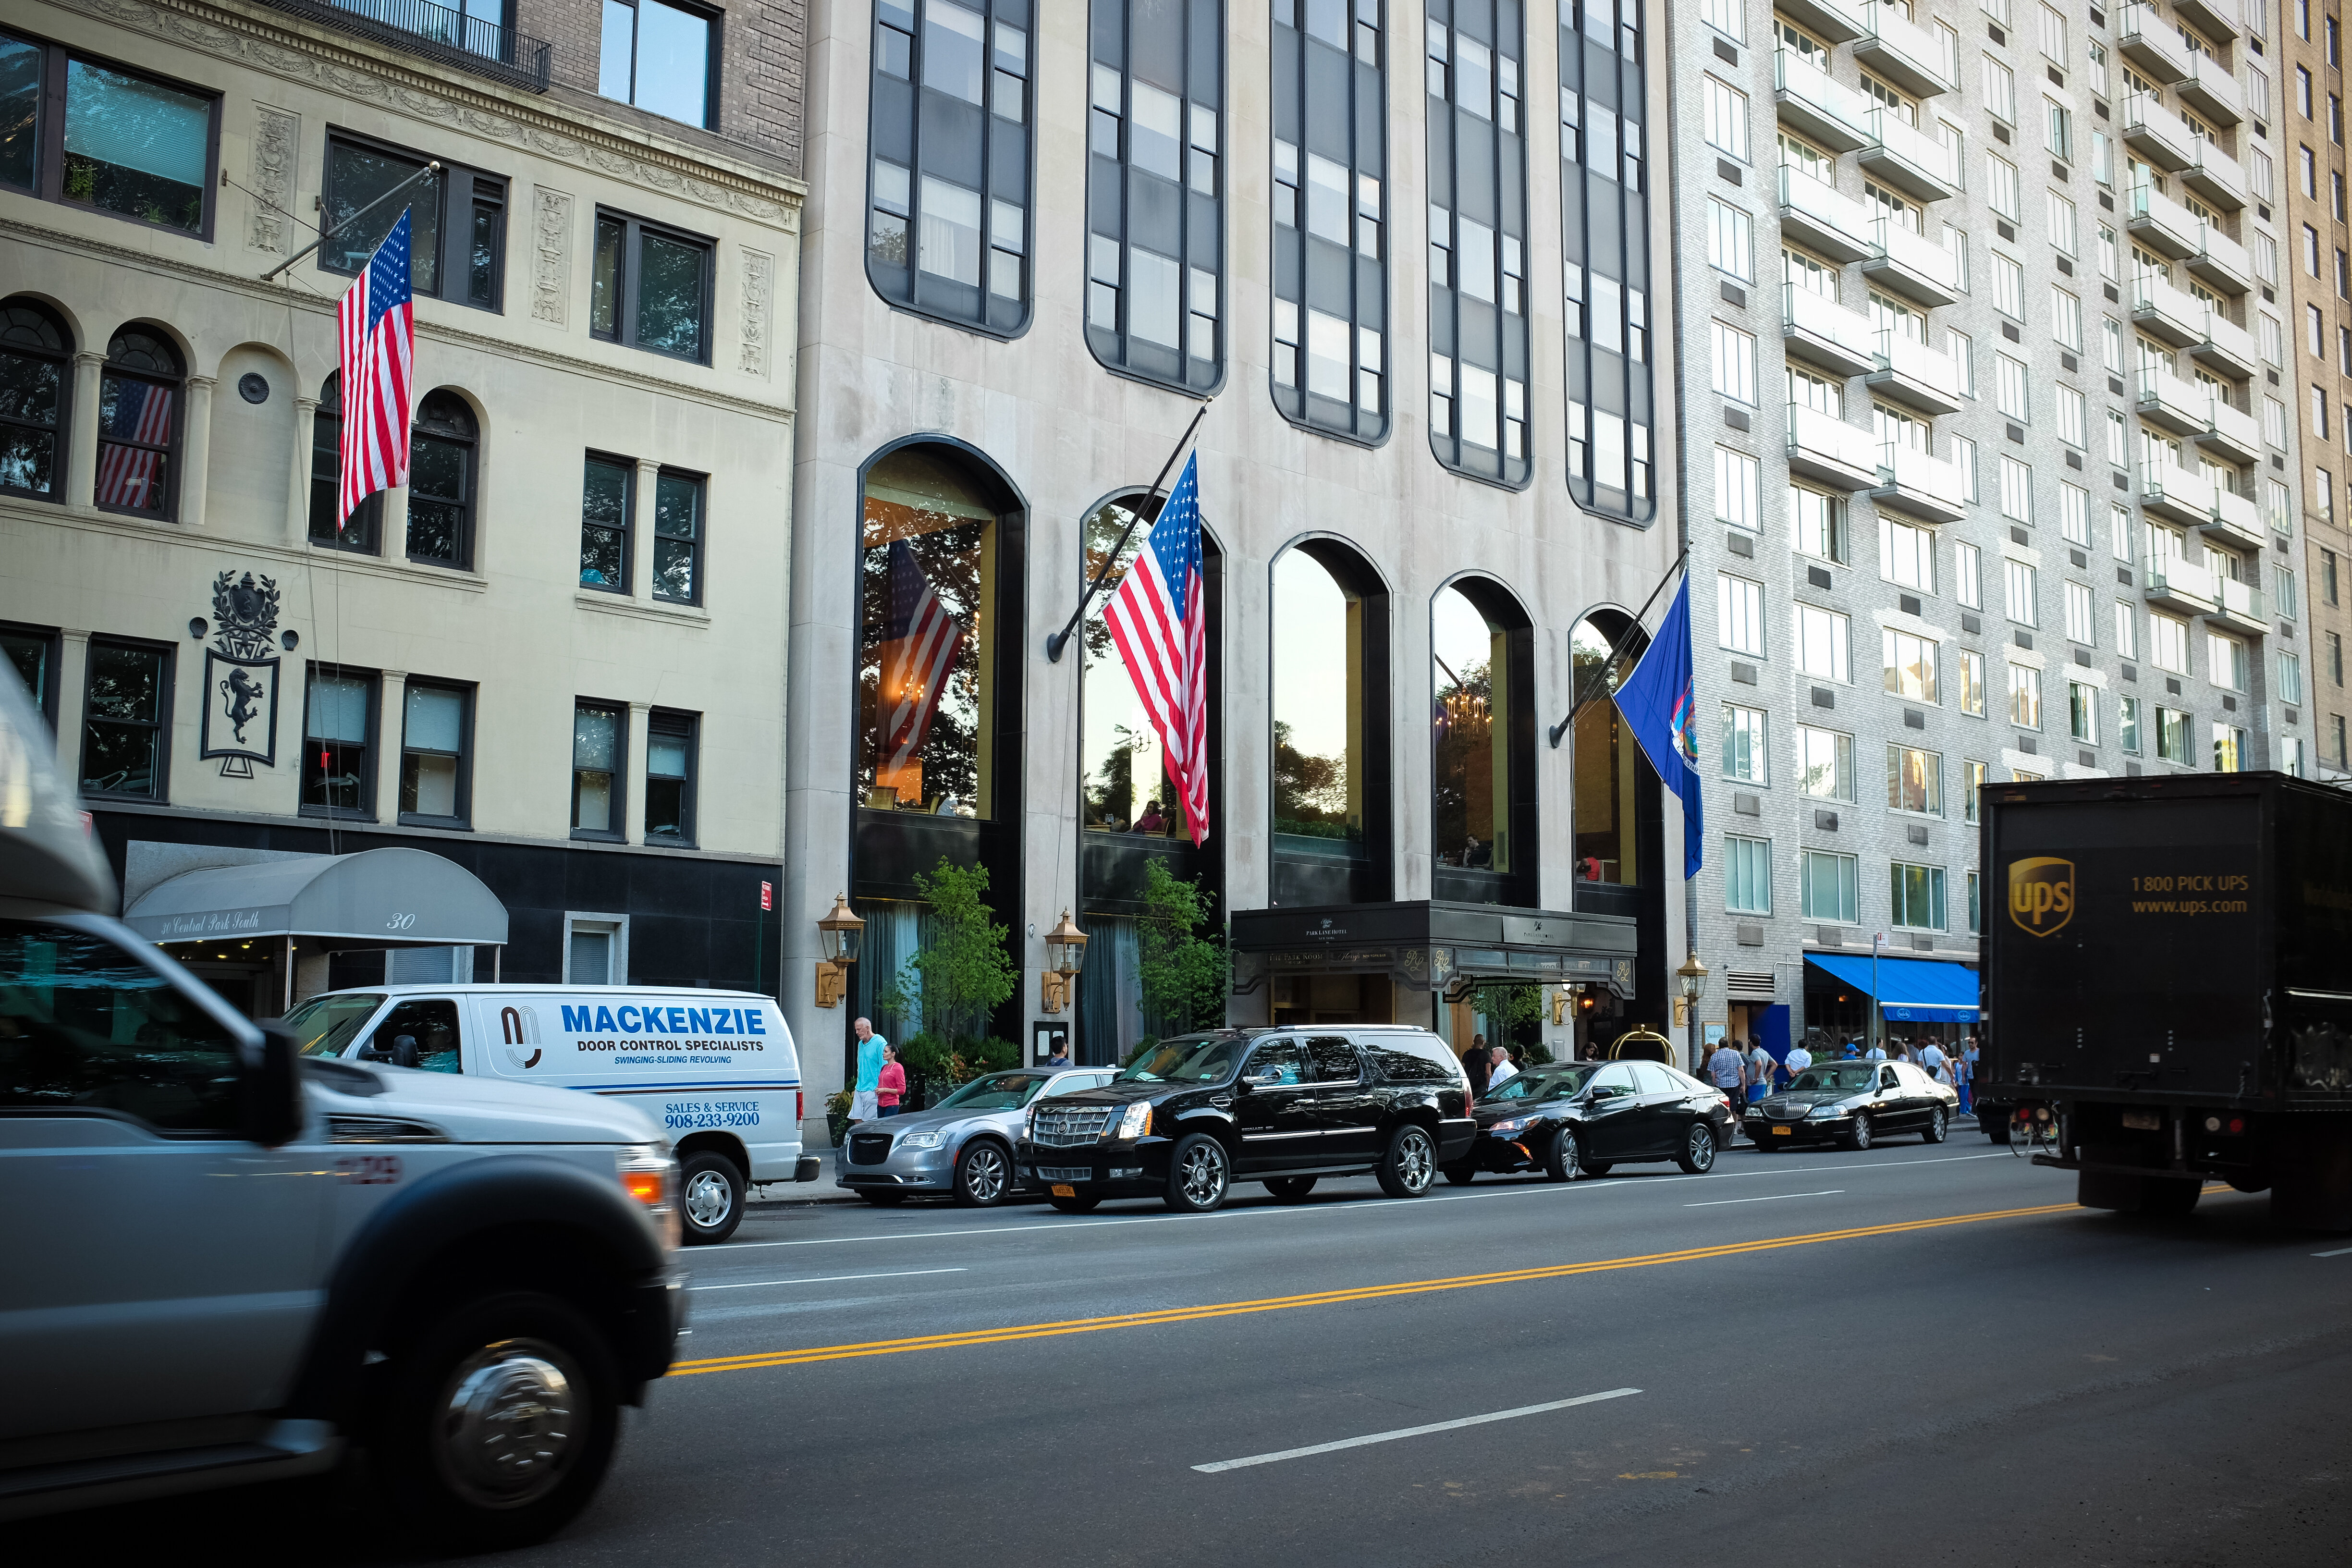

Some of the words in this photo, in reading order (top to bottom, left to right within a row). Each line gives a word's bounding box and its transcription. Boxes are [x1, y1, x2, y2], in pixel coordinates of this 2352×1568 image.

[2132, 877, 2139, 891] 1
[2144, 877, 2173, 891] 800
[2178, 876, 2213, 891] PICK
[2218, 876, 2249, 891] UPS
[2013, 882, 2070, 925] ups
[2132, 901, 2247, 916] www.ups.com
[161, 922, 171, 934] 30
[173, 916, 206, 933] Central
[208, 914, 230, 931] Park
[233, 911, 259, 929] South
[386, 913, 415, 930] 30
[1303, 952, 1323, 960] ROOM
[561, 1005, 767, 1035] MACKENZIE
[578, 1040, 616, 1051] DOOR
[620, 1040, 681, 1051] CONTROL
[686, 1041, 764, 1052] SPECIALISTS
[615, 1055, 687, 1064] SWINGING-SLIDING
[690, 1055, 732, 1064] REVOLVING
[666, 1102, 700, 1114] SALES
[703, 1102, 712, 1112] &
[715, 1102, 759, 1112] SERVICE
[665, 1112, 760, 1128] 908-233-9200
